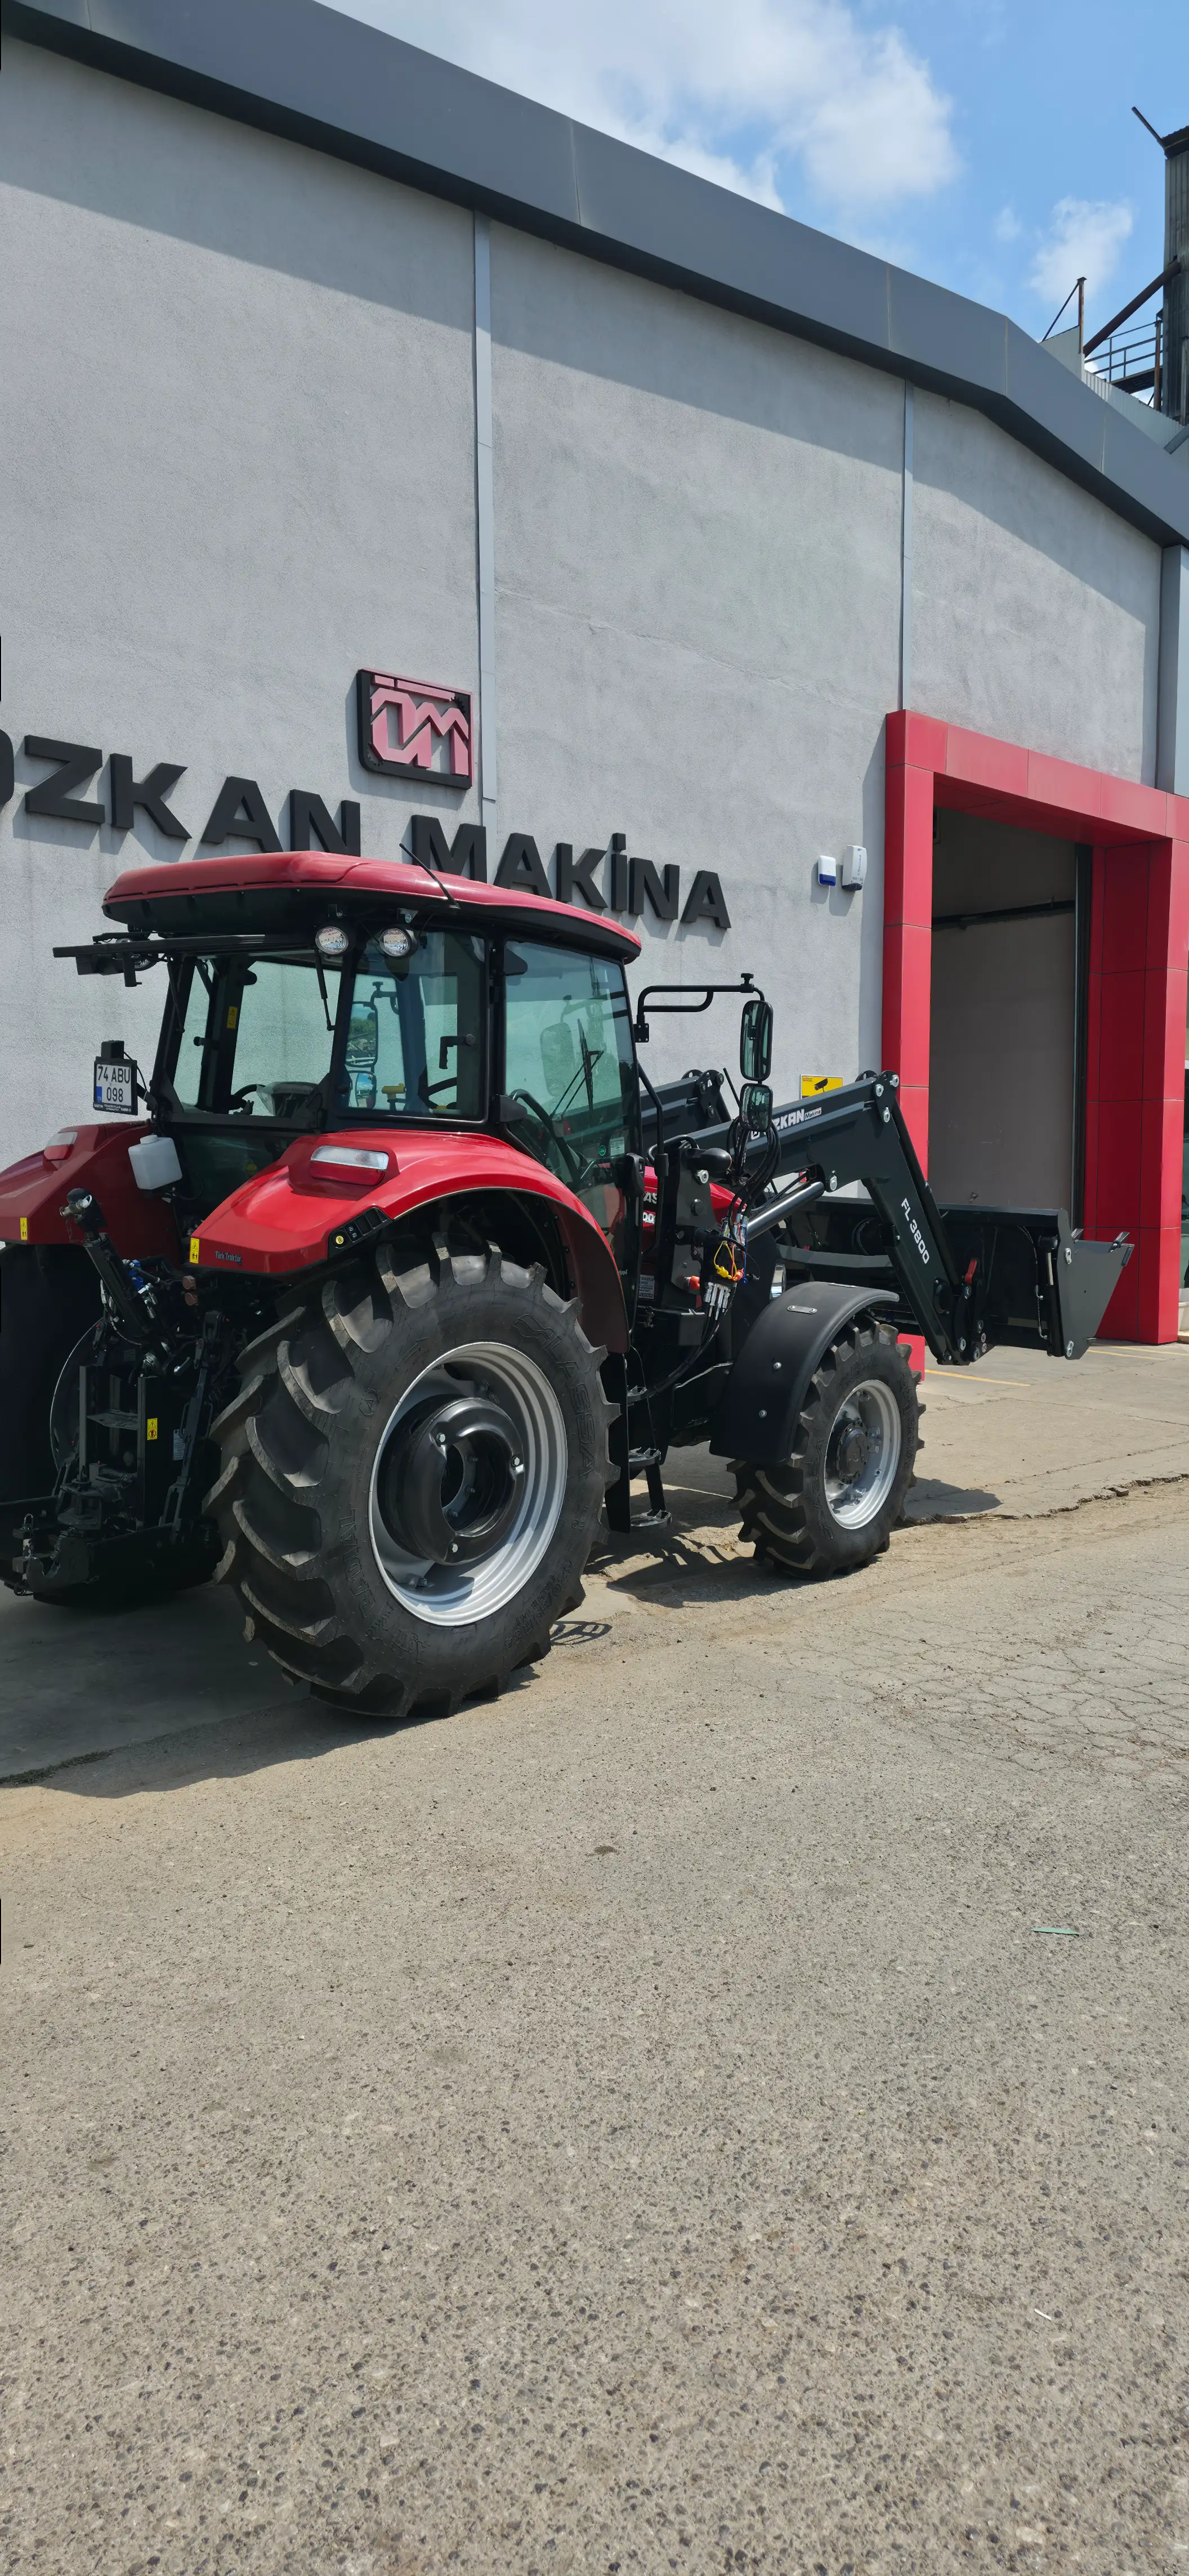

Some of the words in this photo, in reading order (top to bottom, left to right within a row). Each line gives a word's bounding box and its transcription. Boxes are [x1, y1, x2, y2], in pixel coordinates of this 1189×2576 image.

[0, 728, 361, 857] ZKAN
[410, 814, 731, 929] MAKİNA
[97, 1066, 109, 1082] 74
[111, 1067, 131, 1084] ABU
[106, 1086, 123, 1103] 098
[769, 1109, 804, 1132] ZKAN
[805, 1108, 821, 1119] Makina
[901, 1197, 911, 1222] FL
[910, 1219, 930, 1264] 3800
[542, 1335, 596, 1477] LASSA
